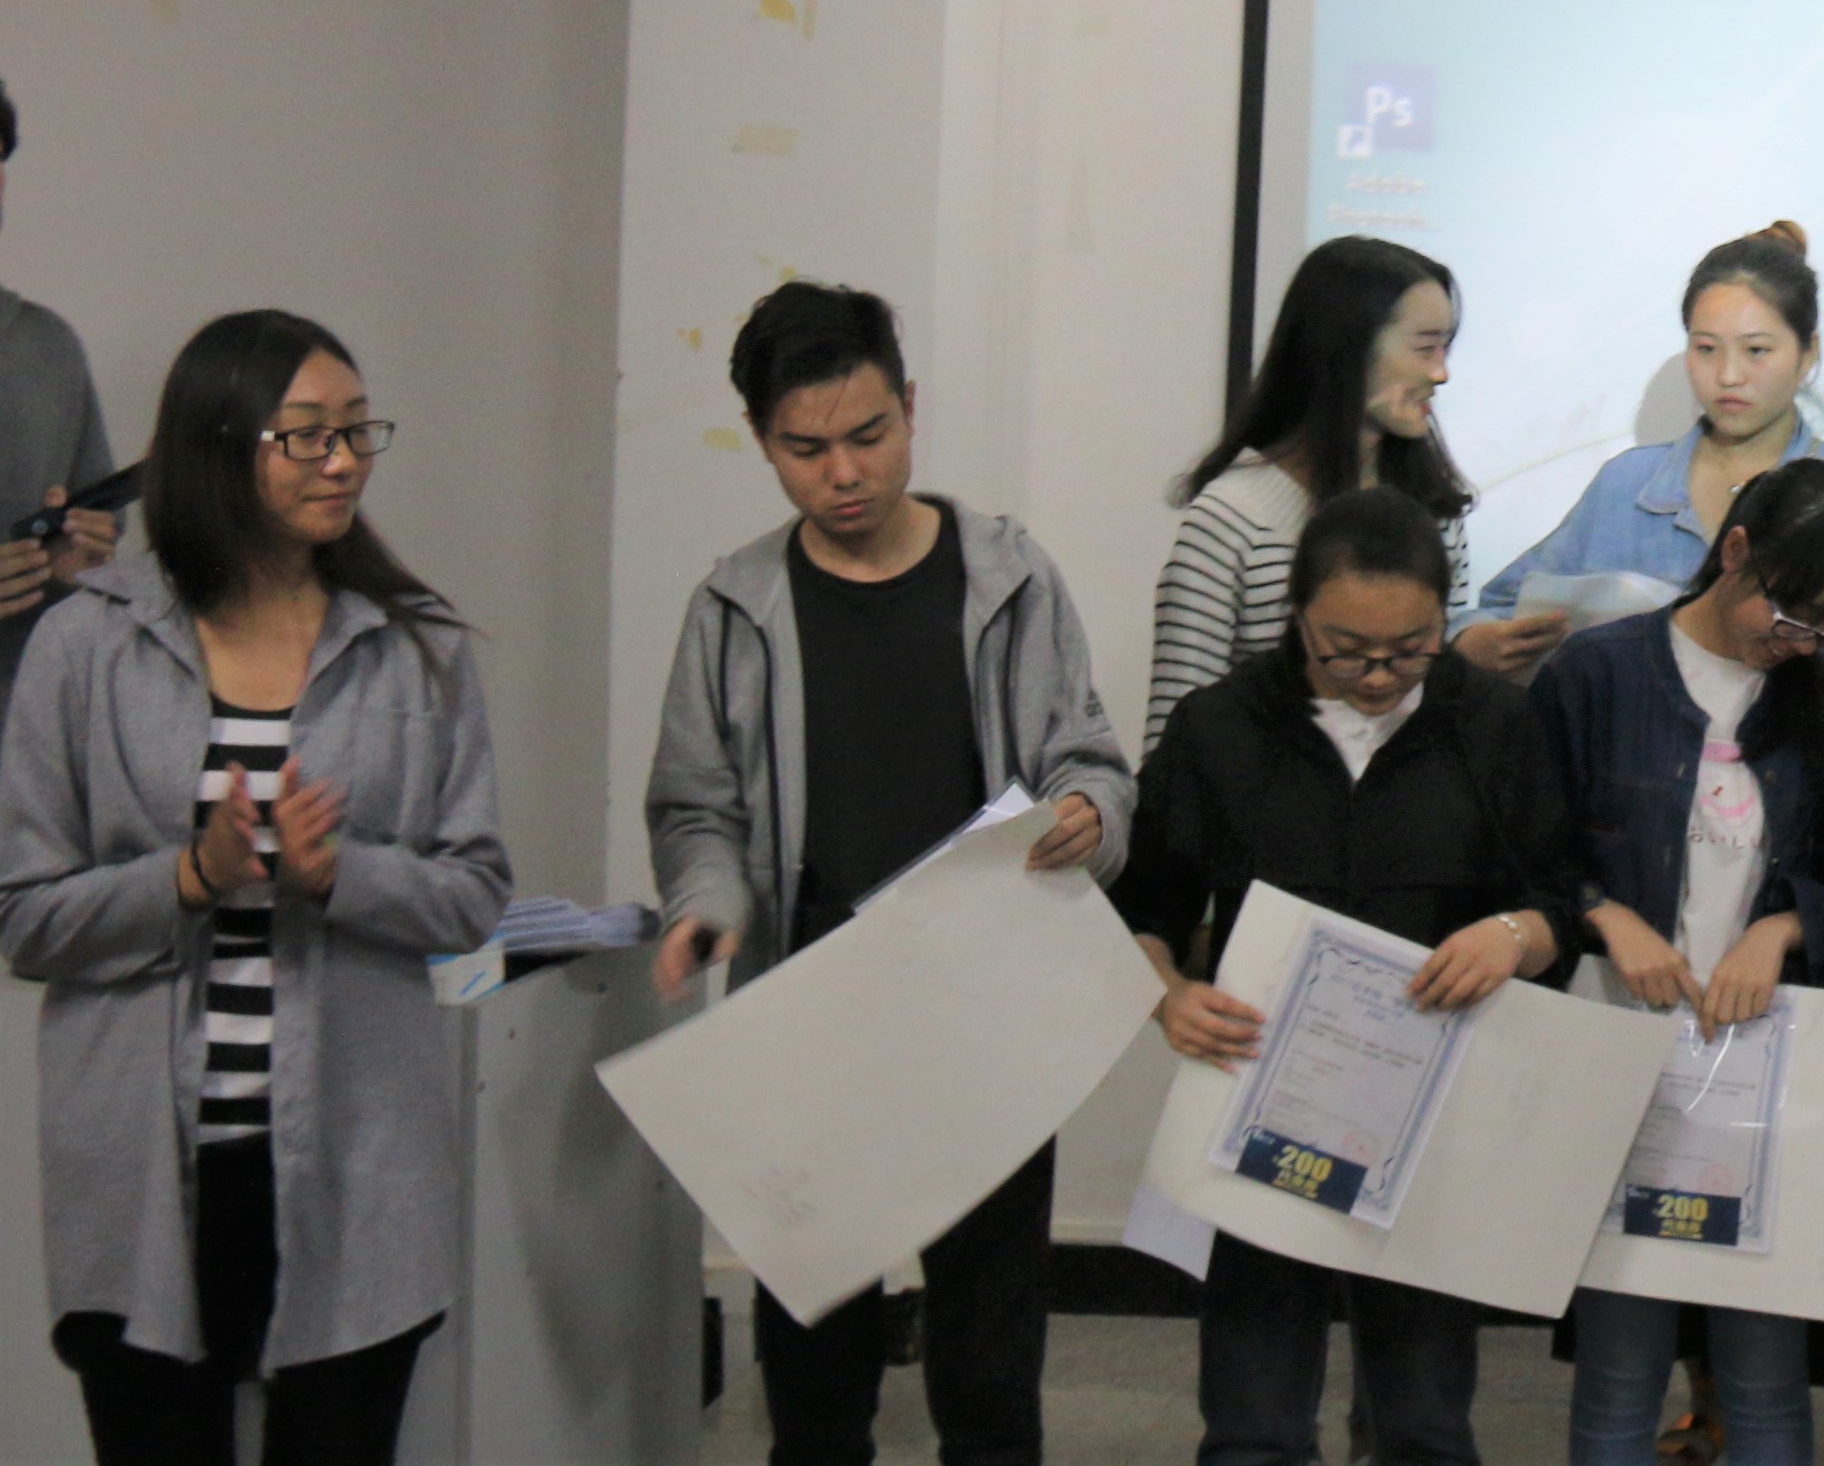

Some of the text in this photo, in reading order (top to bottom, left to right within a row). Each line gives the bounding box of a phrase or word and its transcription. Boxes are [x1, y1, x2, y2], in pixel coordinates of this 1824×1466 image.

[1366, 85, 1414, 127] Ps
[1277, 1143, 1335, 1182] 200
[1656, 1194, 1710, 1221] 200
